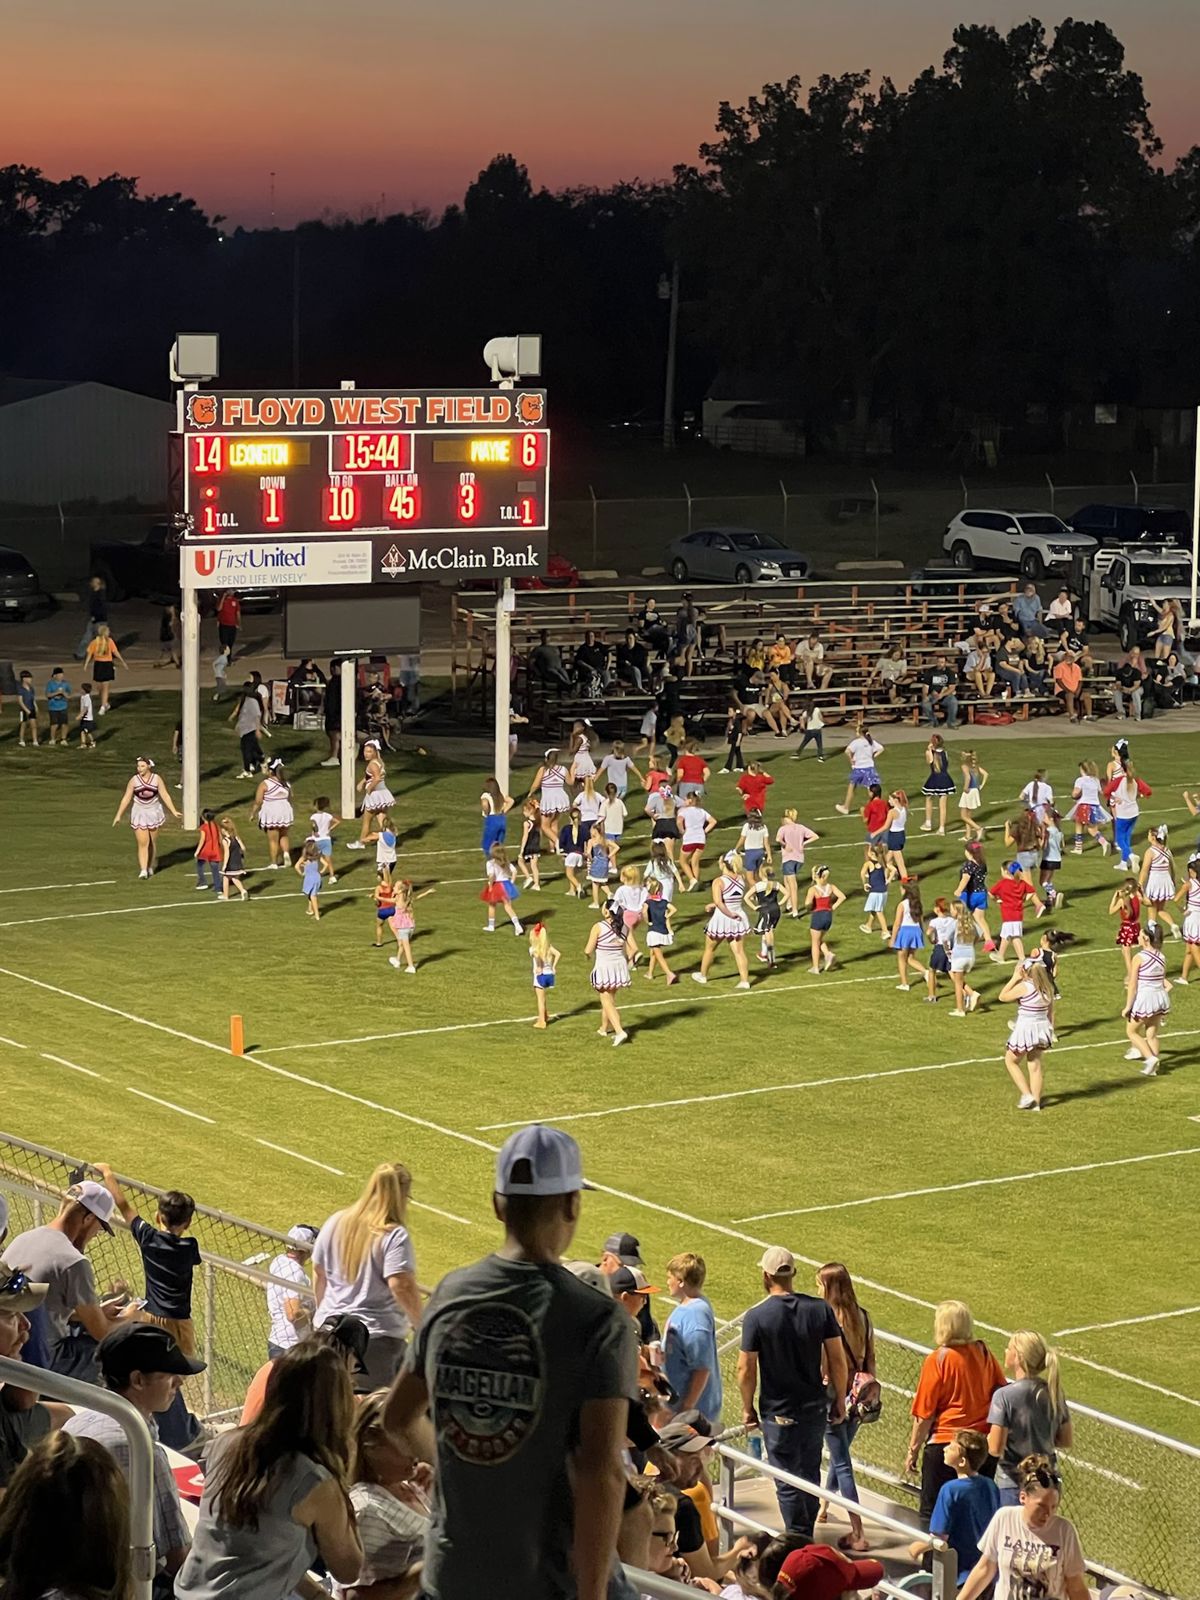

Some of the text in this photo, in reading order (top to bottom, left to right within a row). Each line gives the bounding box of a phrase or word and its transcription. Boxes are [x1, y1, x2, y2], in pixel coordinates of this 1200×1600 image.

[222, 396, 511, 425] FLOYD WEST FIELD
[195, 437, 221, 472] 14
[345, 435, 399, 469] 15:44
[522, 433, 537, 466] 6
[260, 476, 286, 490] DOWN
[329, 475, 354, 487] TO GO
[385, 473, 418, 487] BALL ON
[265, 488, 280, 523] 1
[328, 487, 354, 521] 10
[389, 486, 414, 519] 45
[461, 484, 475, 518] 3
[500, 500, 533, 525] T.O.L. 1
[204, 507, 239, 533] 1 T.O.L.
[408, 545, 539, 570] McClain Bank
[216, 575, 247, 586] SPEND
[251, 574, 268, 584] LIFE
